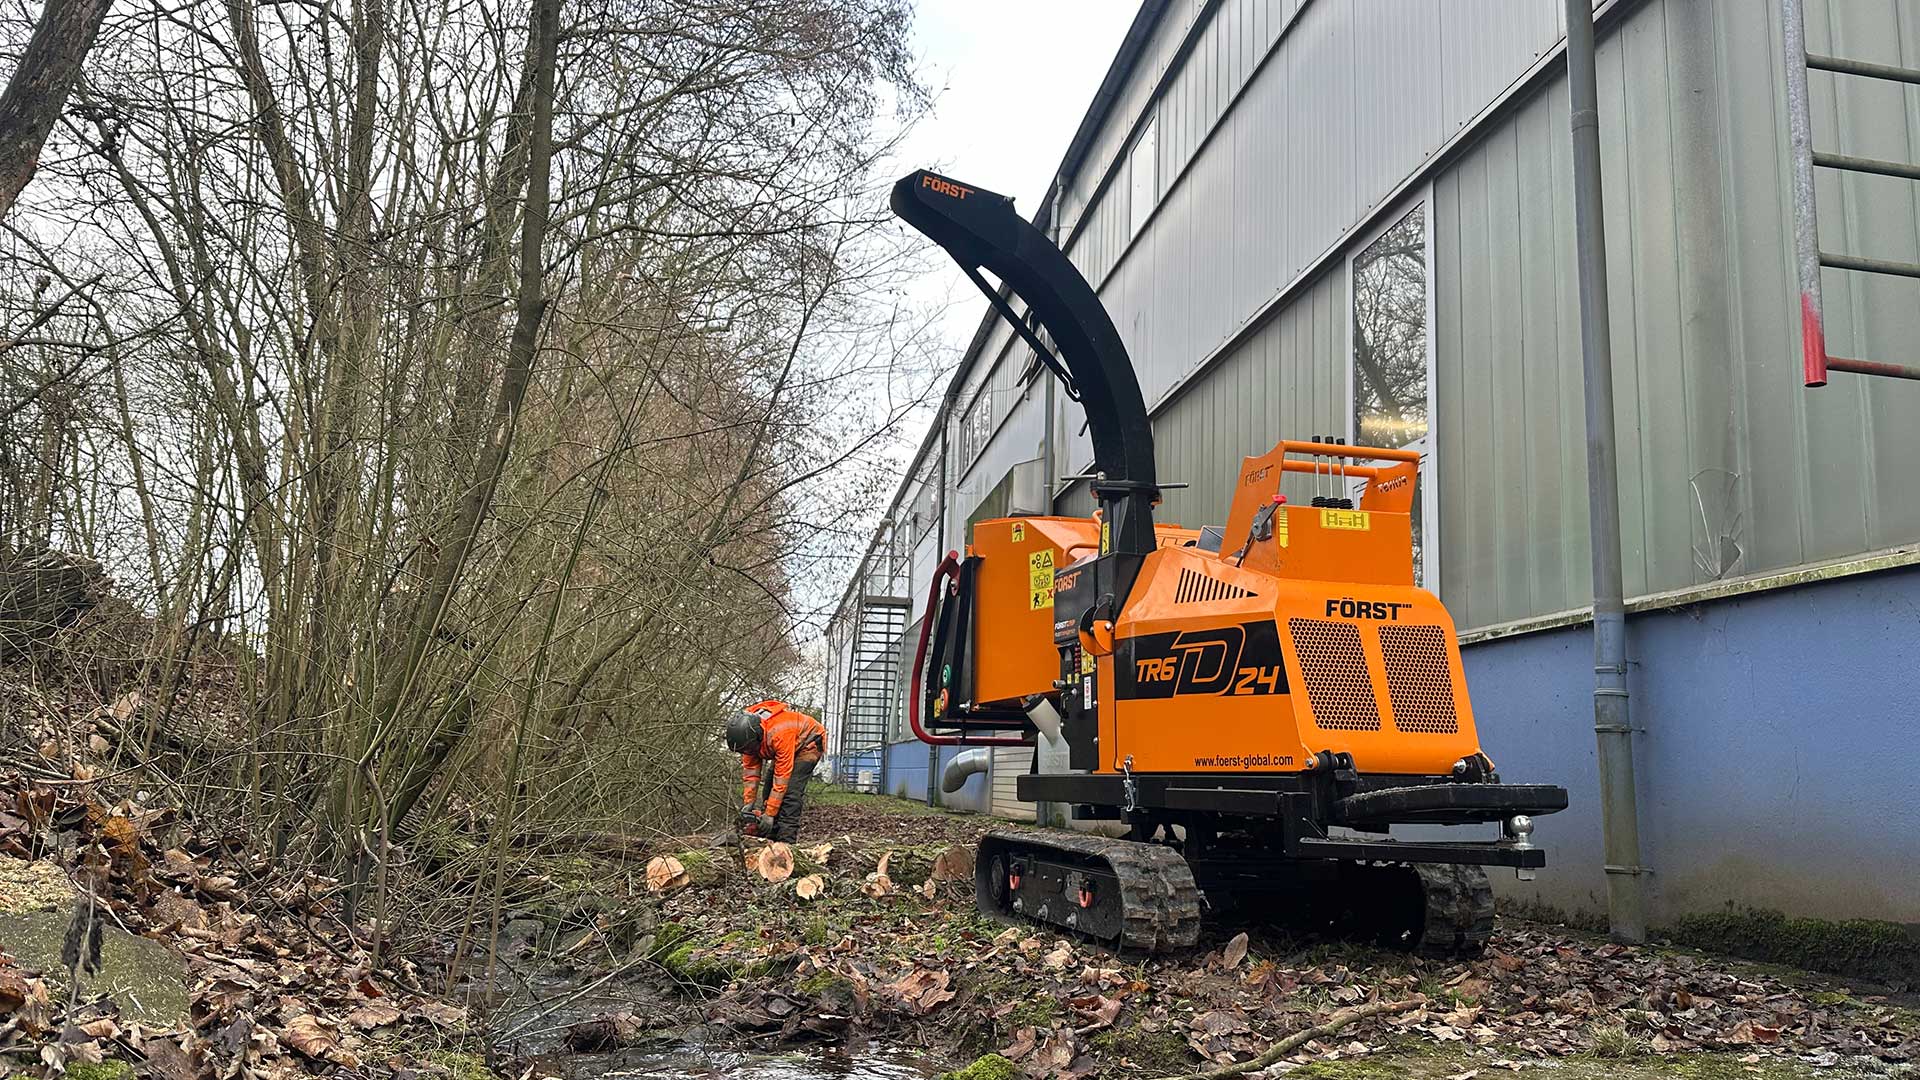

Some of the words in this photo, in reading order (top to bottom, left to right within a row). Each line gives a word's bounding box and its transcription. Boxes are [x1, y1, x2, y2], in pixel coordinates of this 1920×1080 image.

[922, 175, 975, 199] FÖRST
[1326, 597, 1412, 620] FÖRST
[1136, 656, 1177, 682] TR6
[1234, 665, 1280, 695] 24
[1195, 753, 1294, 769] www.foerst-global.com
